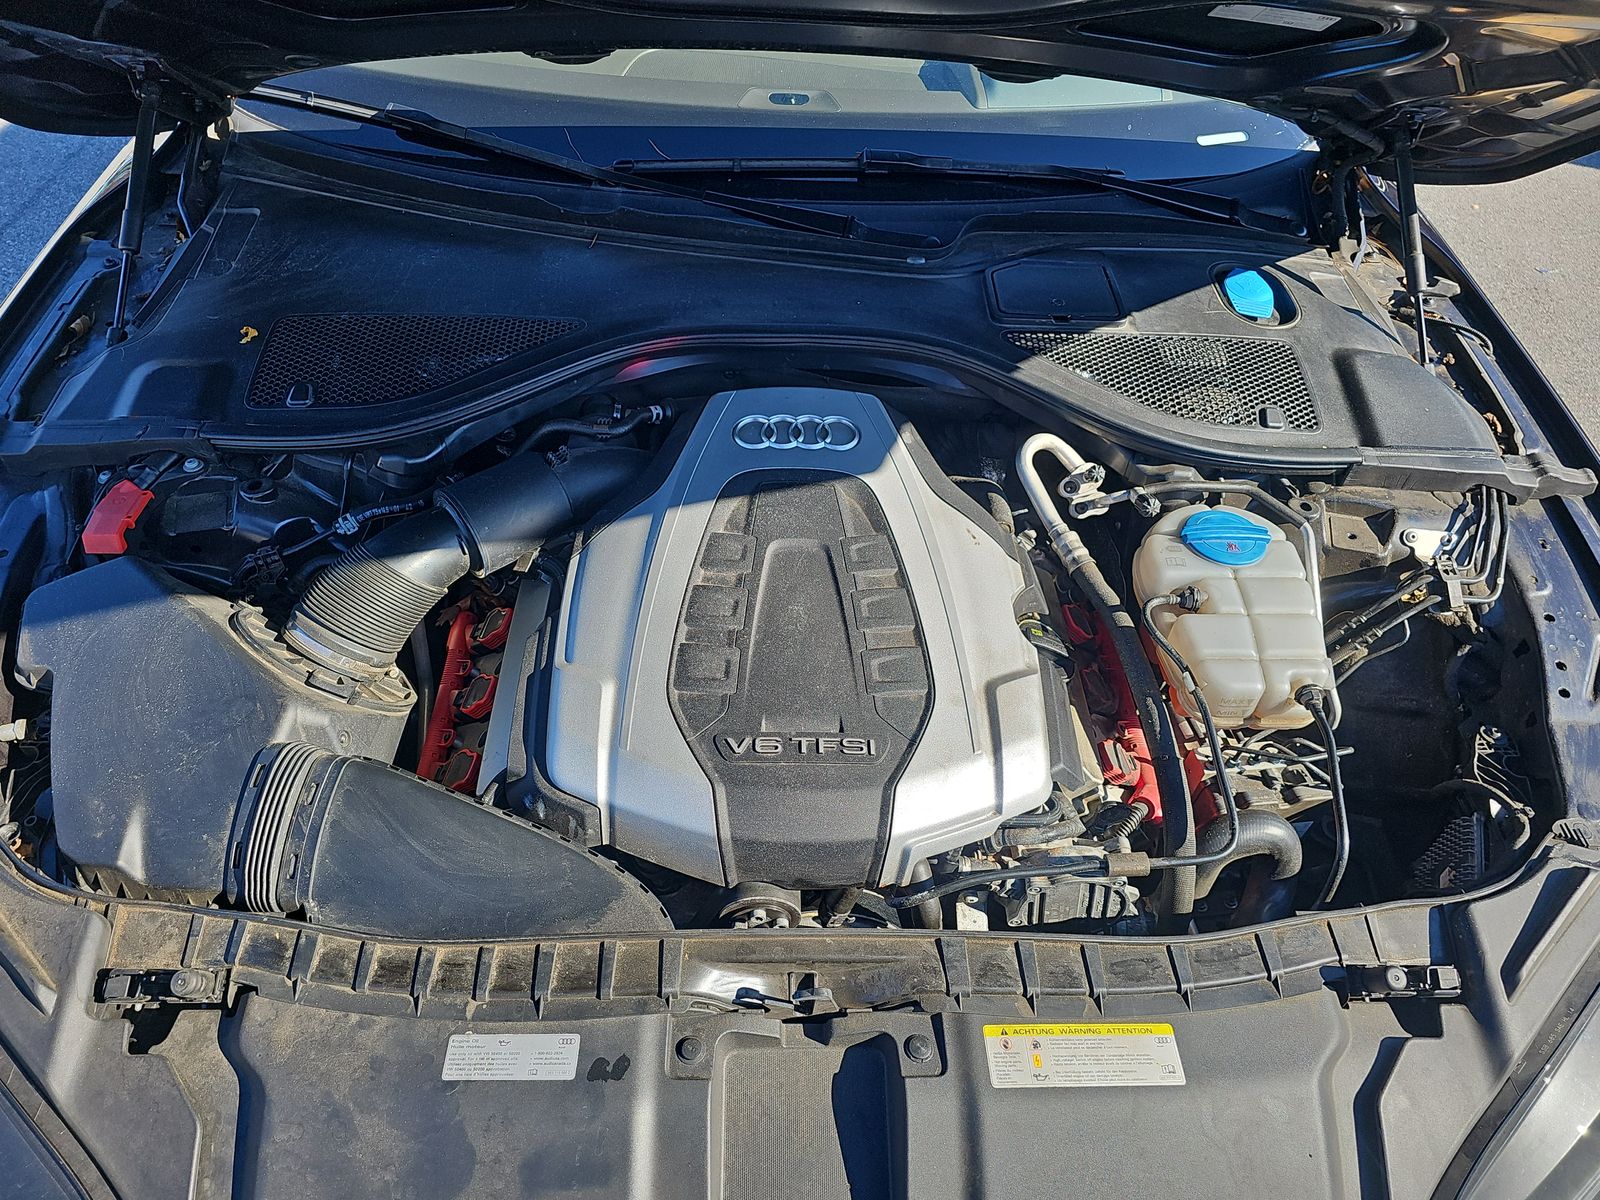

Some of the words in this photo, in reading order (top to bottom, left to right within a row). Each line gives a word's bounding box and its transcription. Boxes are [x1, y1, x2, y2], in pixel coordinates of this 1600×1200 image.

[723, 736, 783, 755] V6
[789, 737, 876, 756] TFSI
[1058, 1027, 1102, 1035] WARNING
